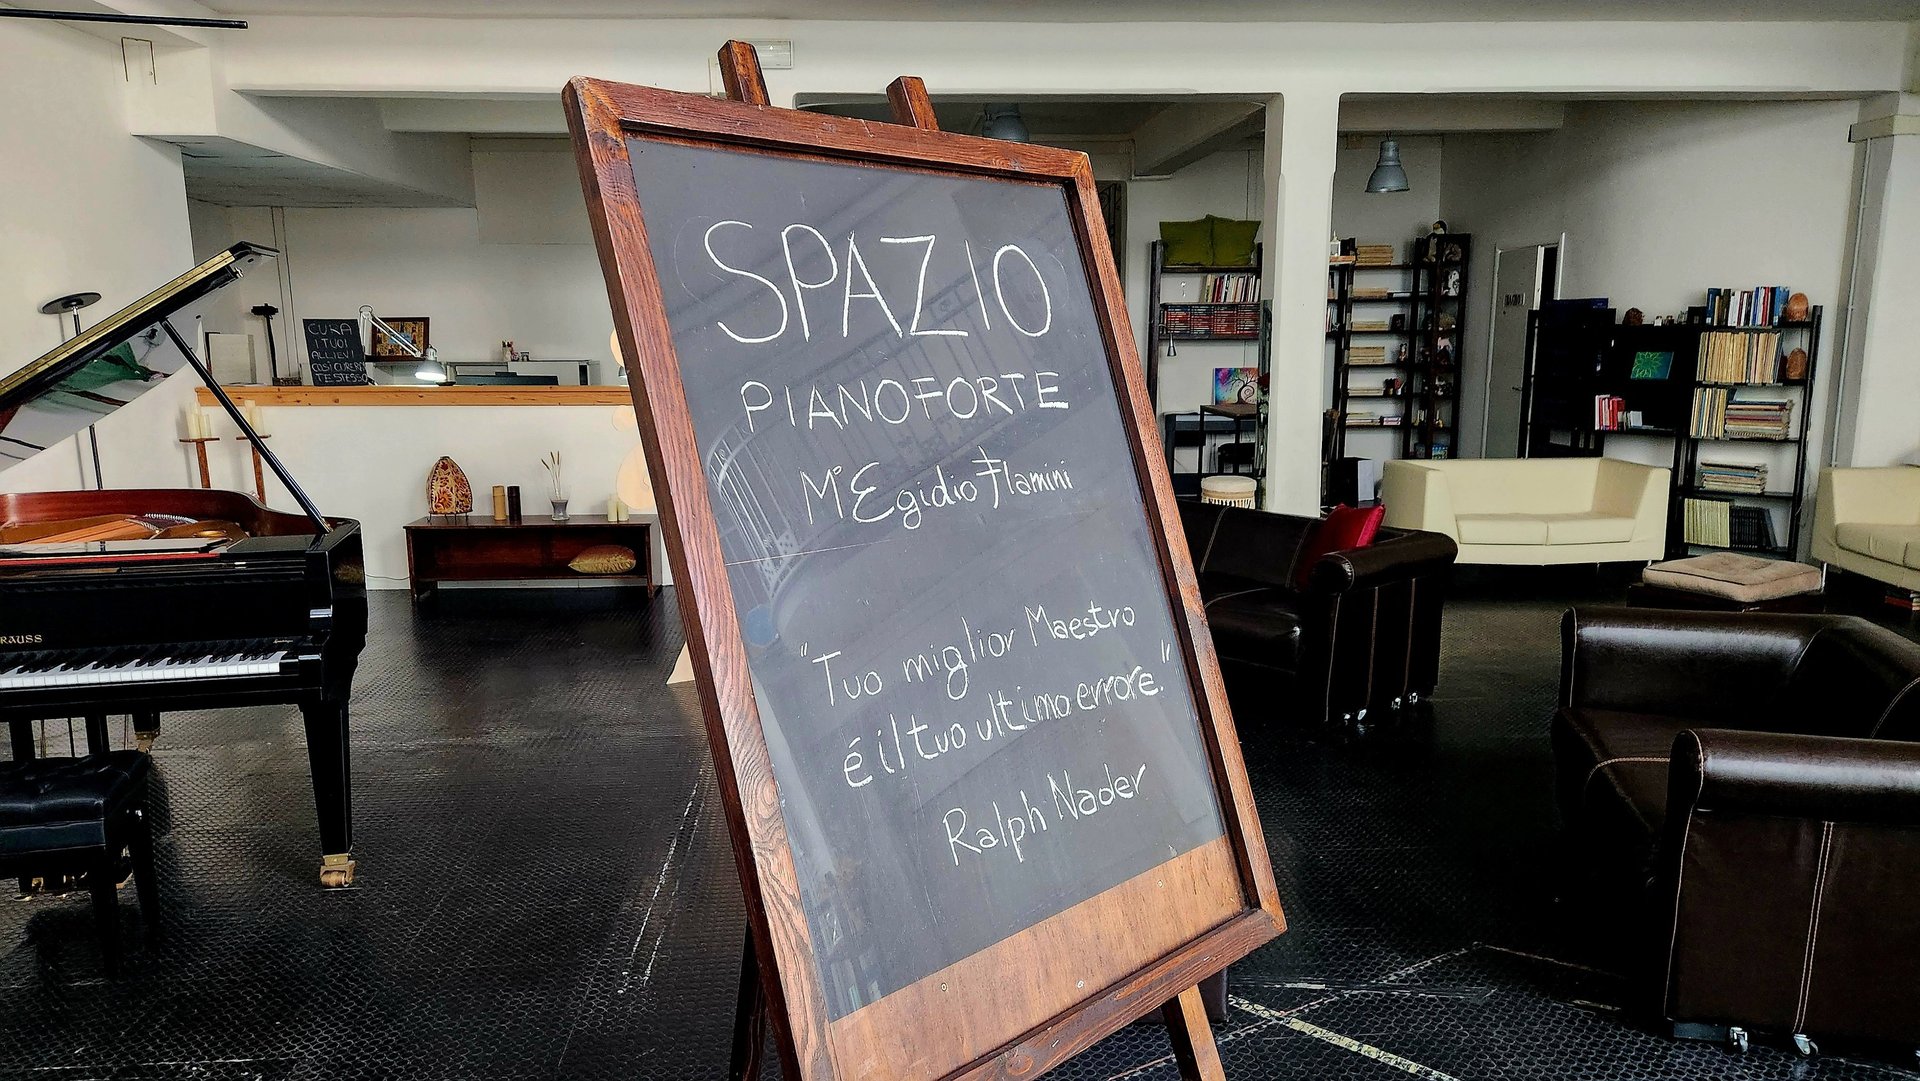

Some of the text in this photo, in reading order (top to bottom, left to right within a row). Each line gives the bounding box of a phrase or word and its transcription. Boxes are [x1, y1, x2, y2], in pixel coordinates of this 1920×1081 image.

[704, 220, 1052, 343] SPAZIO
[311, 350, 354, 360] ALLIEVI
[321, 338, 348, 349] TUOI
[740, 370, 1070, 432] PIANOFORTE
[850, 461, 977, 529] Egidio
[972, 445, 1074, 509] Flamini
[0, 634, 43, 645] RAUSS
[902, 616, 1016, 700] miglior
[1024, 600, 1136, 647] Maestro
[877, 713, 906, 775] il
[906, 714, 967, 760] tuo
[976, 685, 1072, 742] ultimo
[942, 763, 1146, 866] Ralph Nader
